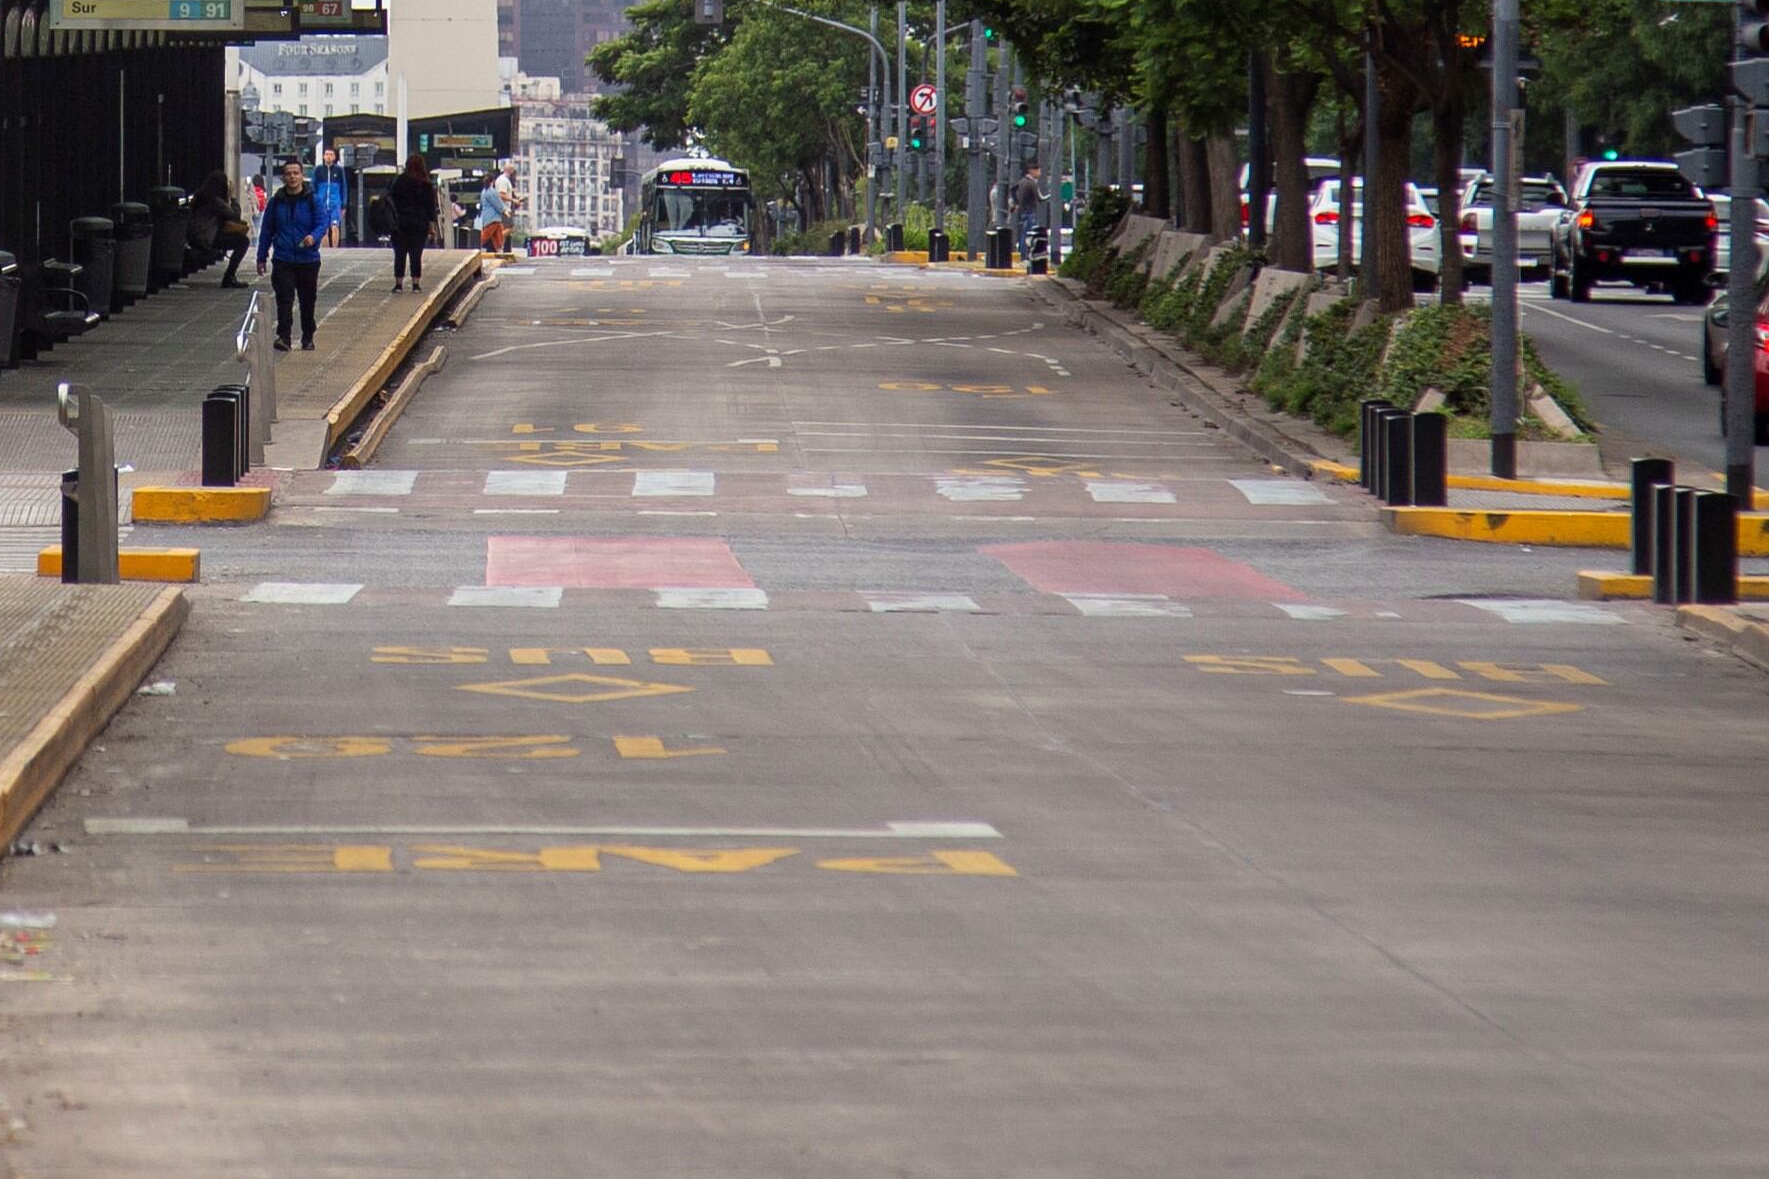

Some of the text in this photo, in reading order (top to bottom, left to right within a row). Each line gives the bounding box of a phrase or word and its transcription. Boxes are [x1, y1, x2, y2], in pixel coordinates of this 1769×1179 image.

[71, 1, 226, 19] Sur 9 91
[322, 3, 338, 16] 67
[278, 43, 357, 56] FOUR SEASONS
[534, 240, 558, 255] 100
[173, 843, 1020, 877] PARE
